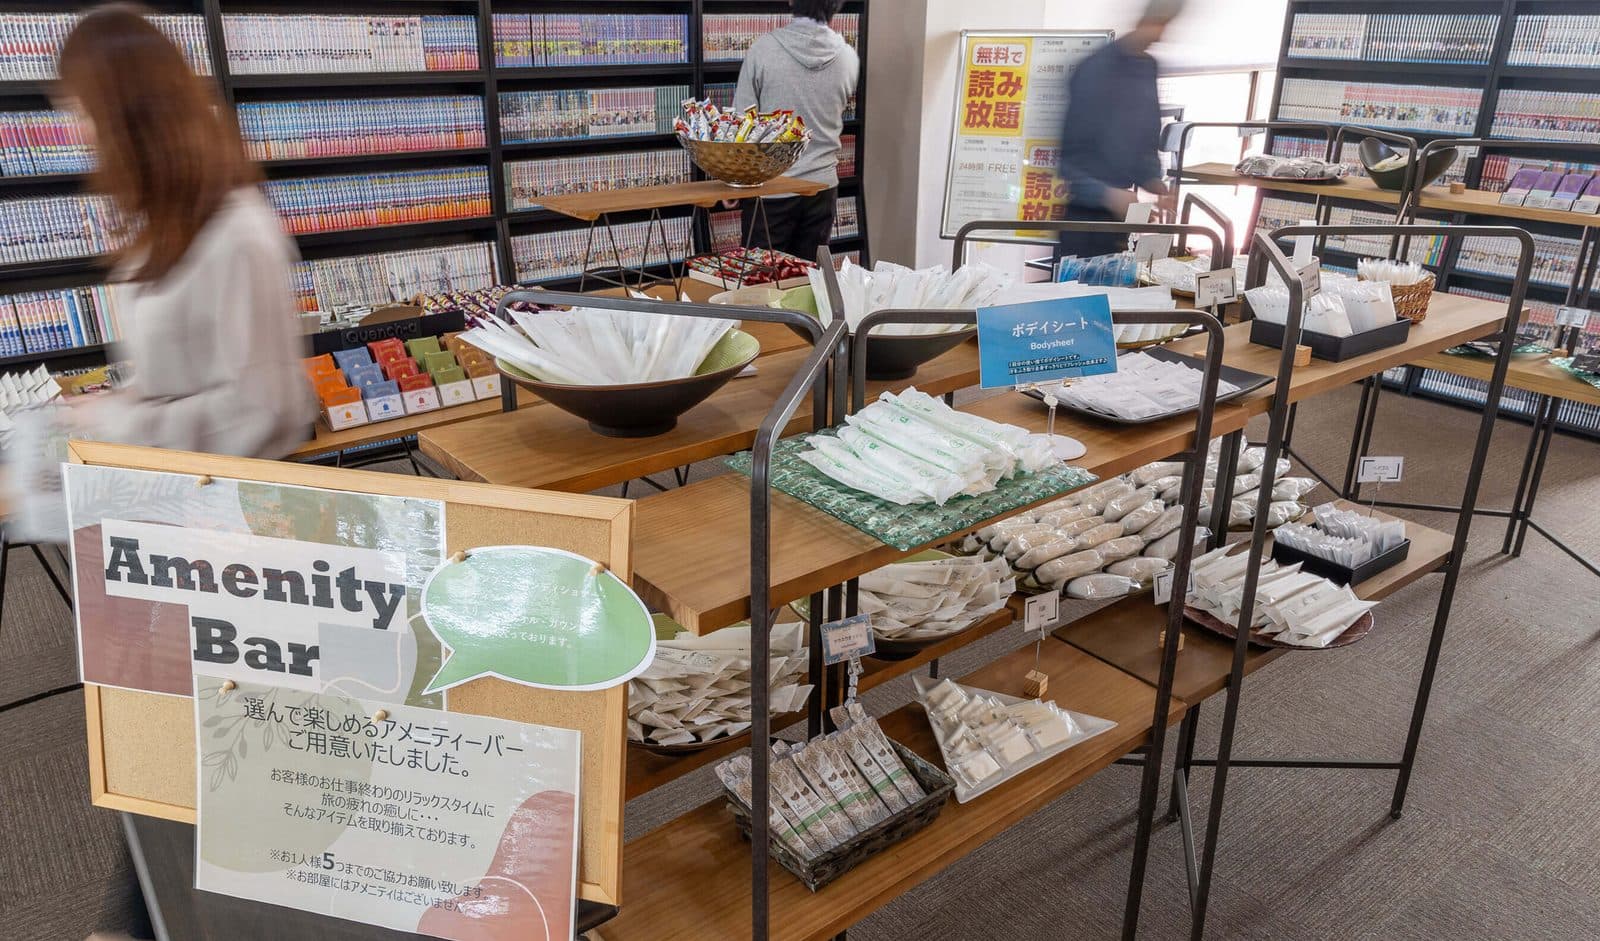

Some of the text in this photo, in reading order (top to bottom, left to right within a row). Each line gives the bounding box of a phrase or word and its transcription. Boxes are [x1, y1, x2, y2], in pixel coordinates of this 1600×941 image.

[976, 46, 1023, 64] 無料で
[968, 70, 1023, 98] 読み
[964, 100, 1021, 129] 放題
[988, 163, 1016, 173] FREE
[1031, 339, 1074, 350] Bodysheet
[105, 535, 406, 630] Amenity
[191, 616, 320, 677] Bar
[243, 696, 524, 756] 選んで楽しめるアメニティーバー
[288, 729, 470, 778] ご用意いたしました。
[271, 768, 495, 818] お客様のお仕事終わりのリラックスタイムに
[283, 802, 476, 850] そんなアイテムを取り揃えております。
